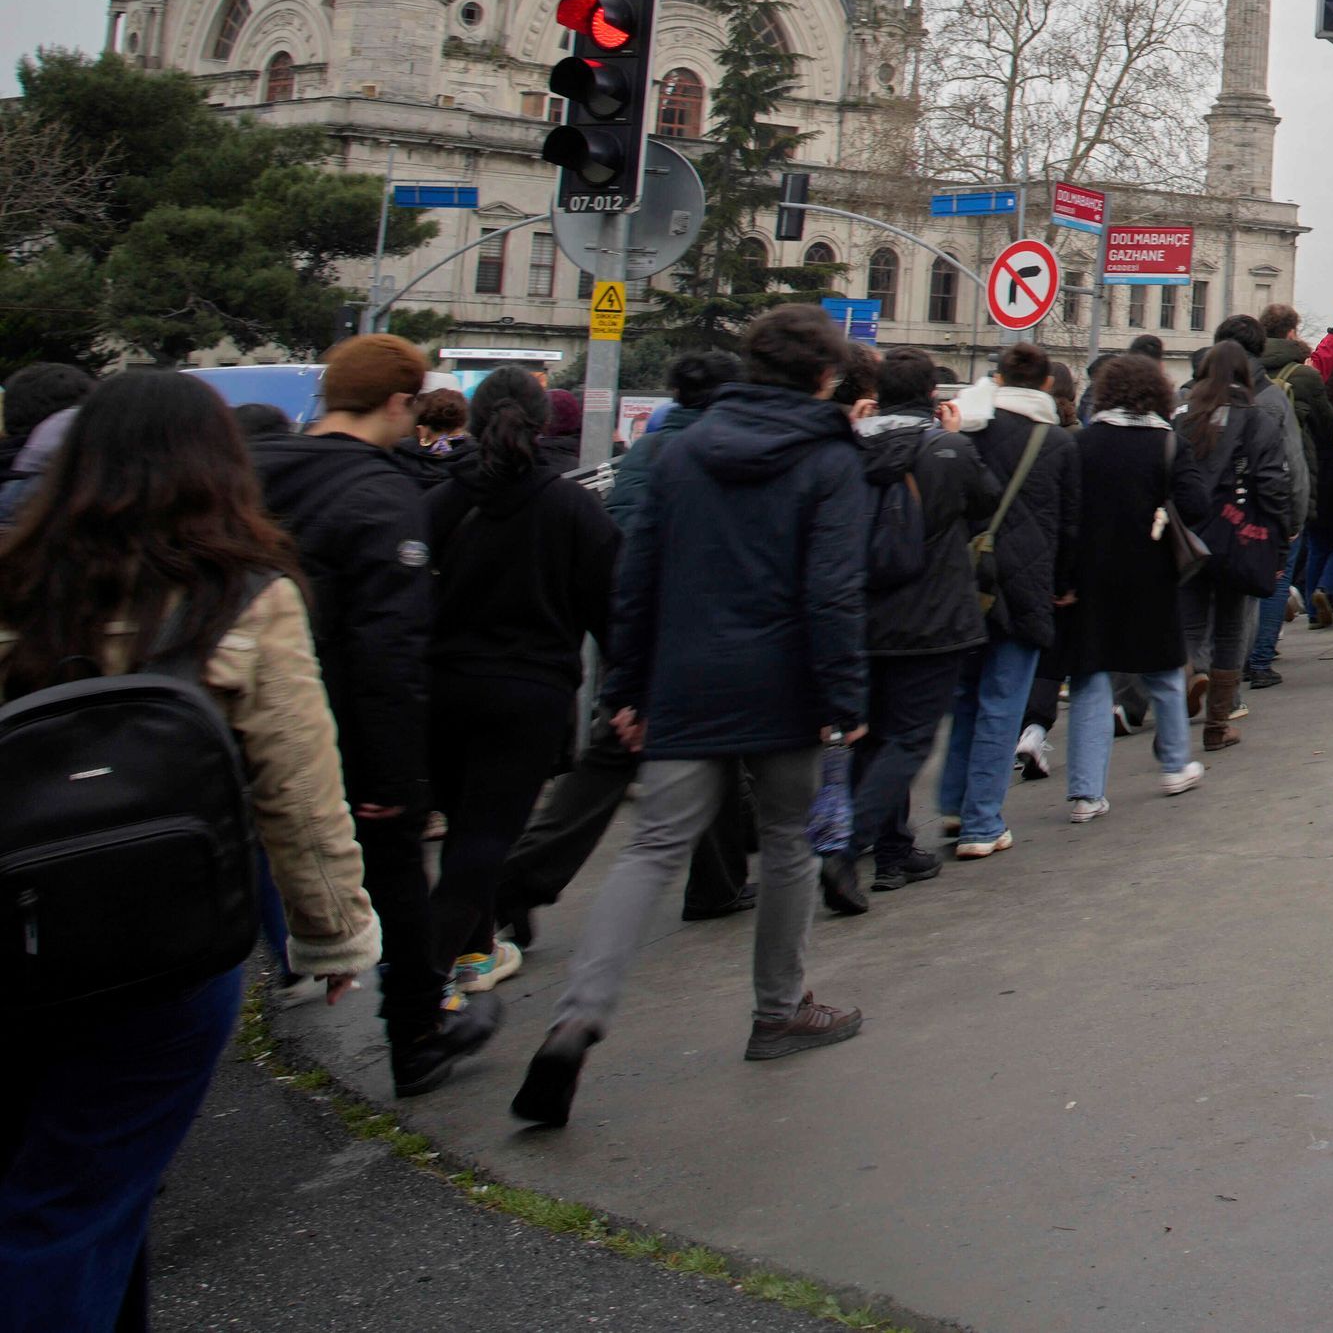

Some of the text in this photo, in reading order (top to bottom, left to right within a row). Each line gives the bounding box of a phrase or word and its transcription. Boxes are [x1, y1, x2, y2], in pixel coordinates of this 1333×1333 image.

[569, 195, 624, 212] 07-012
[1057, 189, 1104, 212] DOLMABAHÇE
[1110, 233, 1191, 247] DOLMABAHÇE
[1108, 249, 1165, 262] GAZHANE
